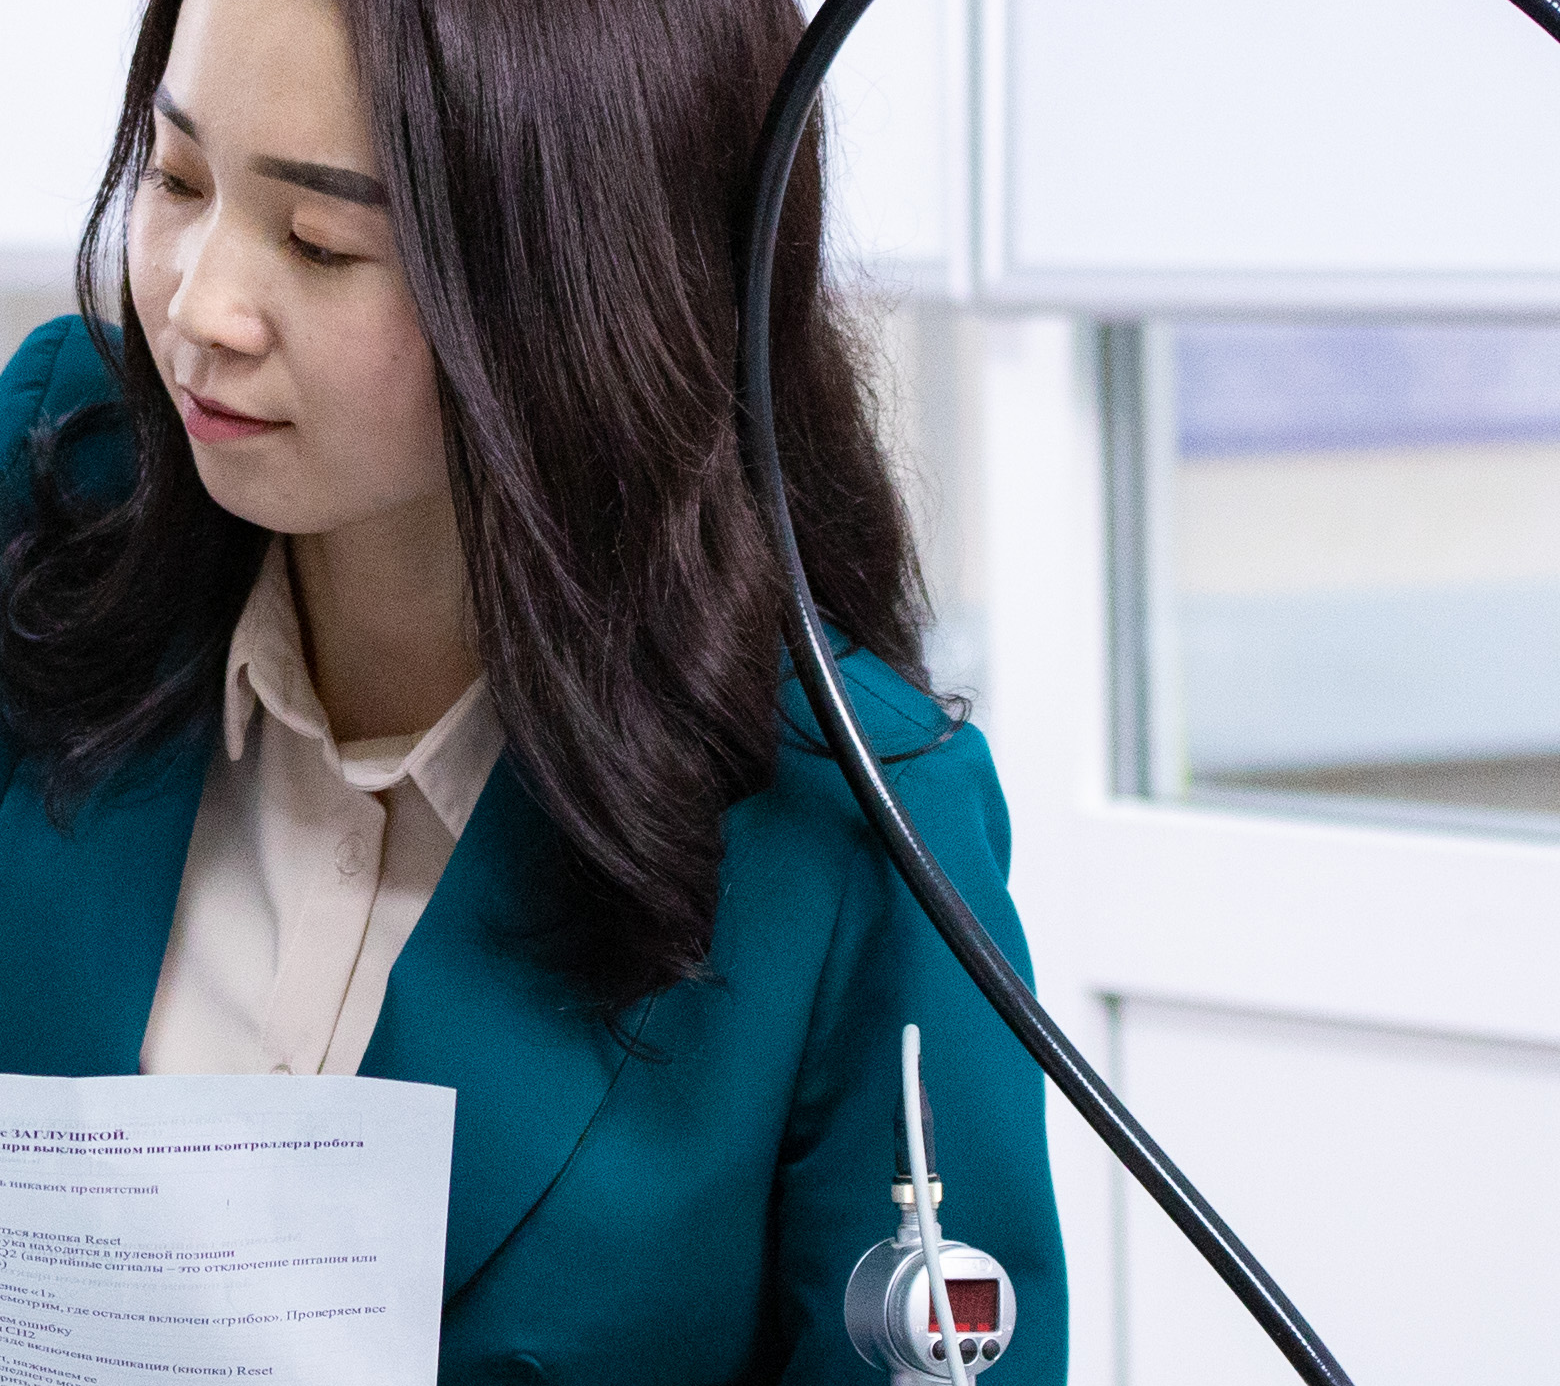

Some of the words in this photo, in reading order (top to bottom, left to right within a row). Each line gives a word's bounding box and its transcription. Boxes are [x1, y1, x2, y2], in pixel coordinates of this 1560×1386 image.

[0, 1129, 7, 1137] с
[11, 1128, 130, 1140] ЗАГЛУШКОЙ.
[1, 1143, 30, 1153] при
[32, 1145, 143, 1155] выключенном
[146, 1144, 211, 1153] питании
[214, 1141, 311, 1151] контроллера
[312, 1138, 363, 1150] робота
[9, 1180, 66, 1192] никаких
[70, 1184, 158, 1195] препятствий
[31, 1231, 80, 1243] кнопка
[84, 1234, 121, 1245] Reset
[28, 1242, 100, 1257] находится
[114, 1250, 172, 1261] нулевой
[175, 1250, 234, 1260] позиции
[20, 1251, 102, 1269] (аварийные
[104, 1263, 163, 1273] сигналы
[178, 1265, 200, 1273] это
[204, 1259, 289, 1272] отключение
[291, 1256, 348, 1265] питания
[351, 1254, 377, 1262] или
[66, 1306, 89, 1315] где
[91, 1309, 145, 1321] остался
[148, 1315, 209, 1324] включен
[286, 1307, 361, 1321] Проверяем
[364, 1305, 386, 1313] все
